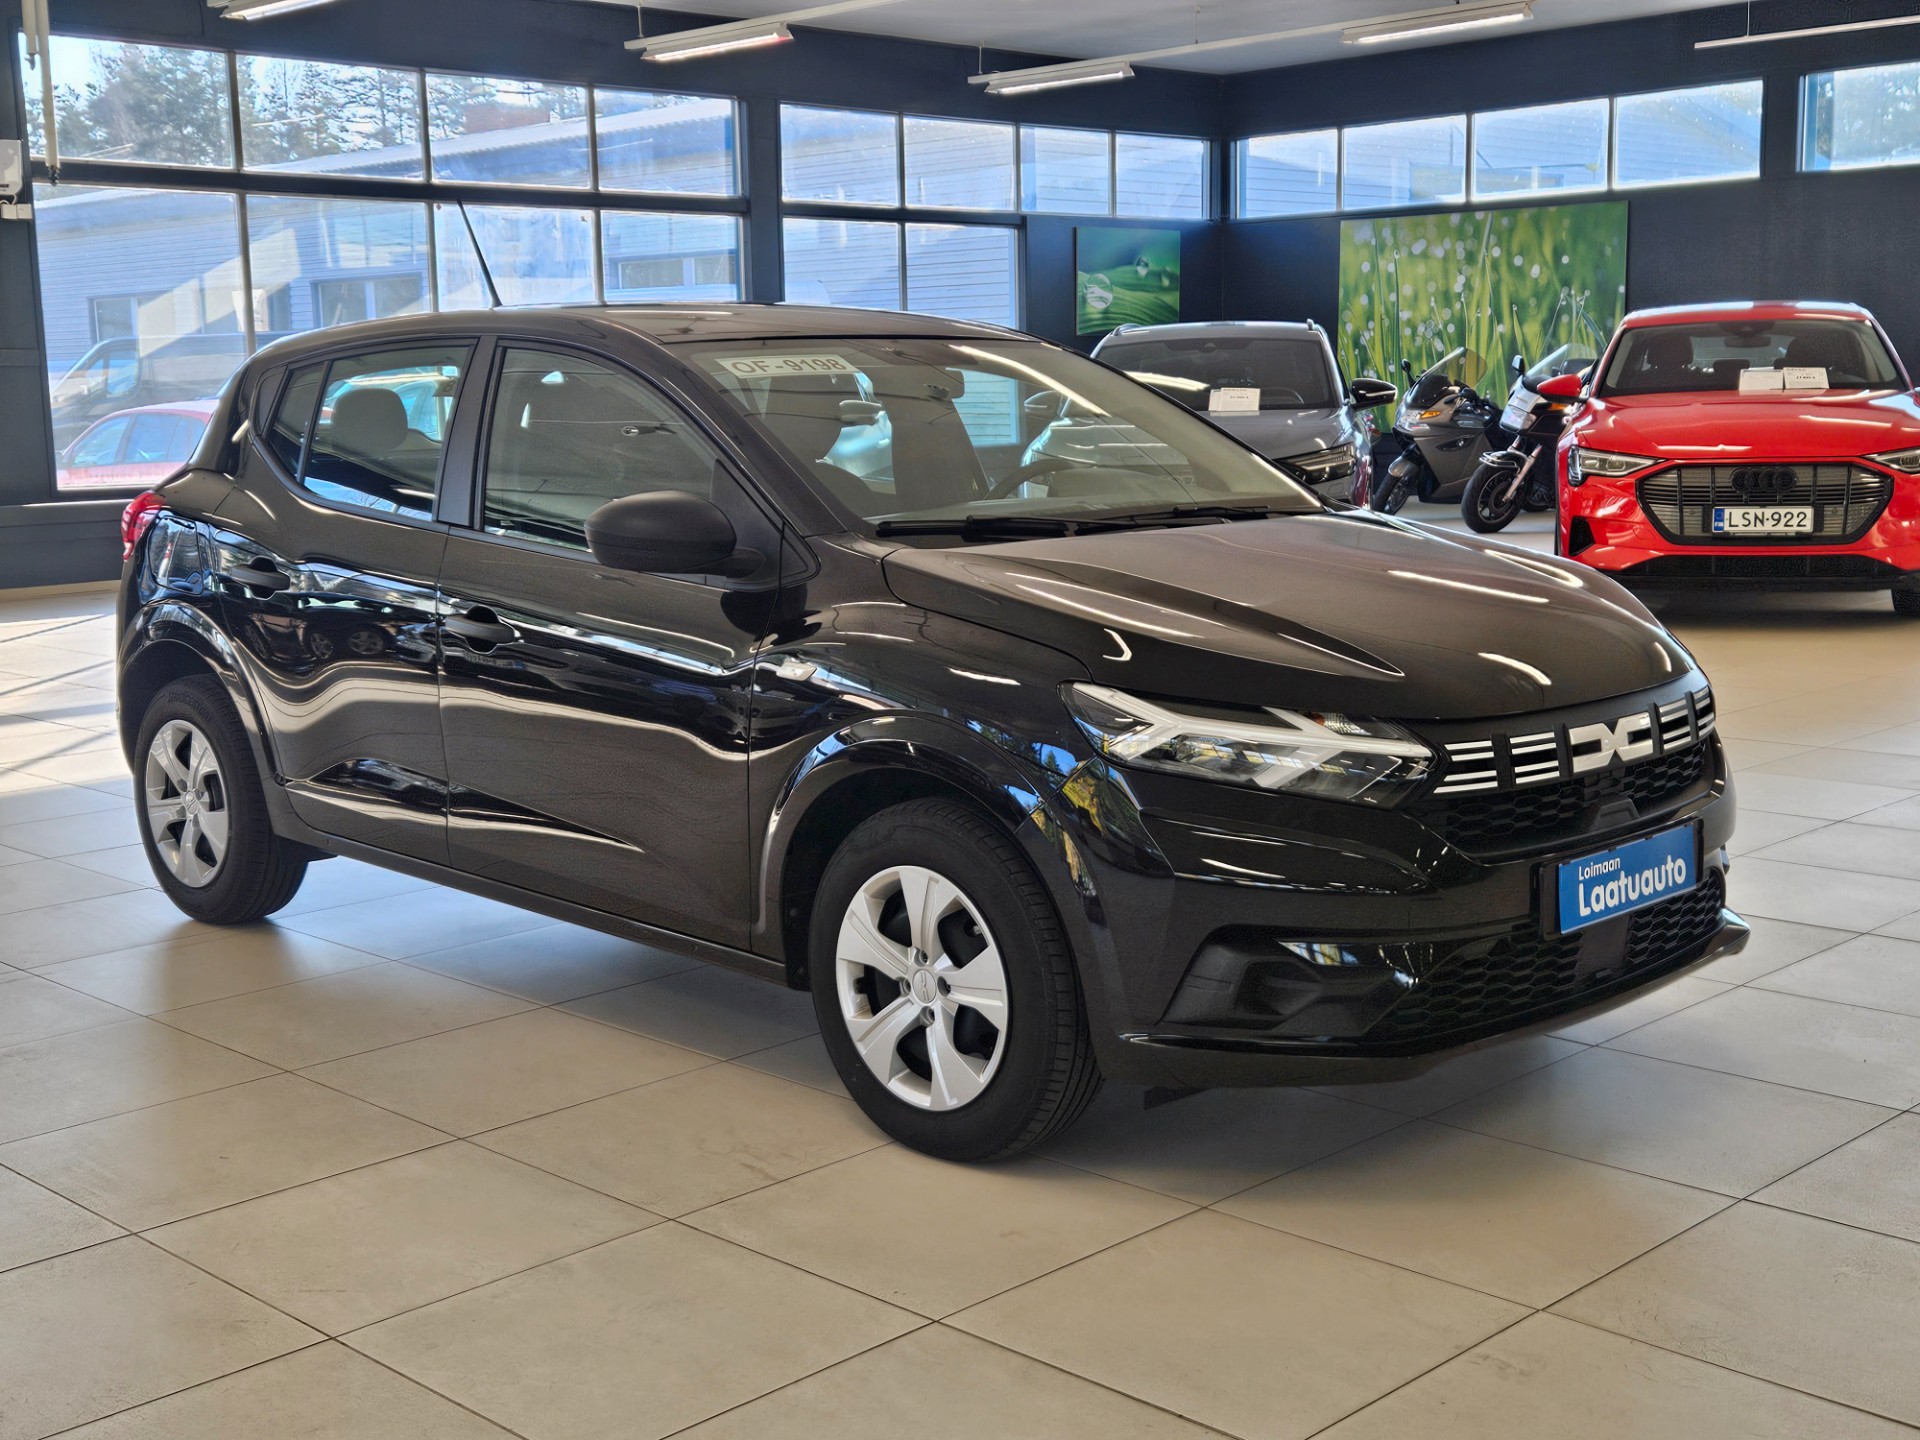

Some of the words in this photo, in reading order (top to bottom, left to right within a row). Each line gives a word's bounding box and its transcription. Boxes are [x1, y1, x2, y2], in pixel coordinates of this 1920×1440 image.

[731, 358, 848, 375] OF-9198
[1728, 511, 1808, 528] LSN-922
[1578, 856, 1621, 881] Loimaan
[1578, 854, 1687, 917] Laatuauto
